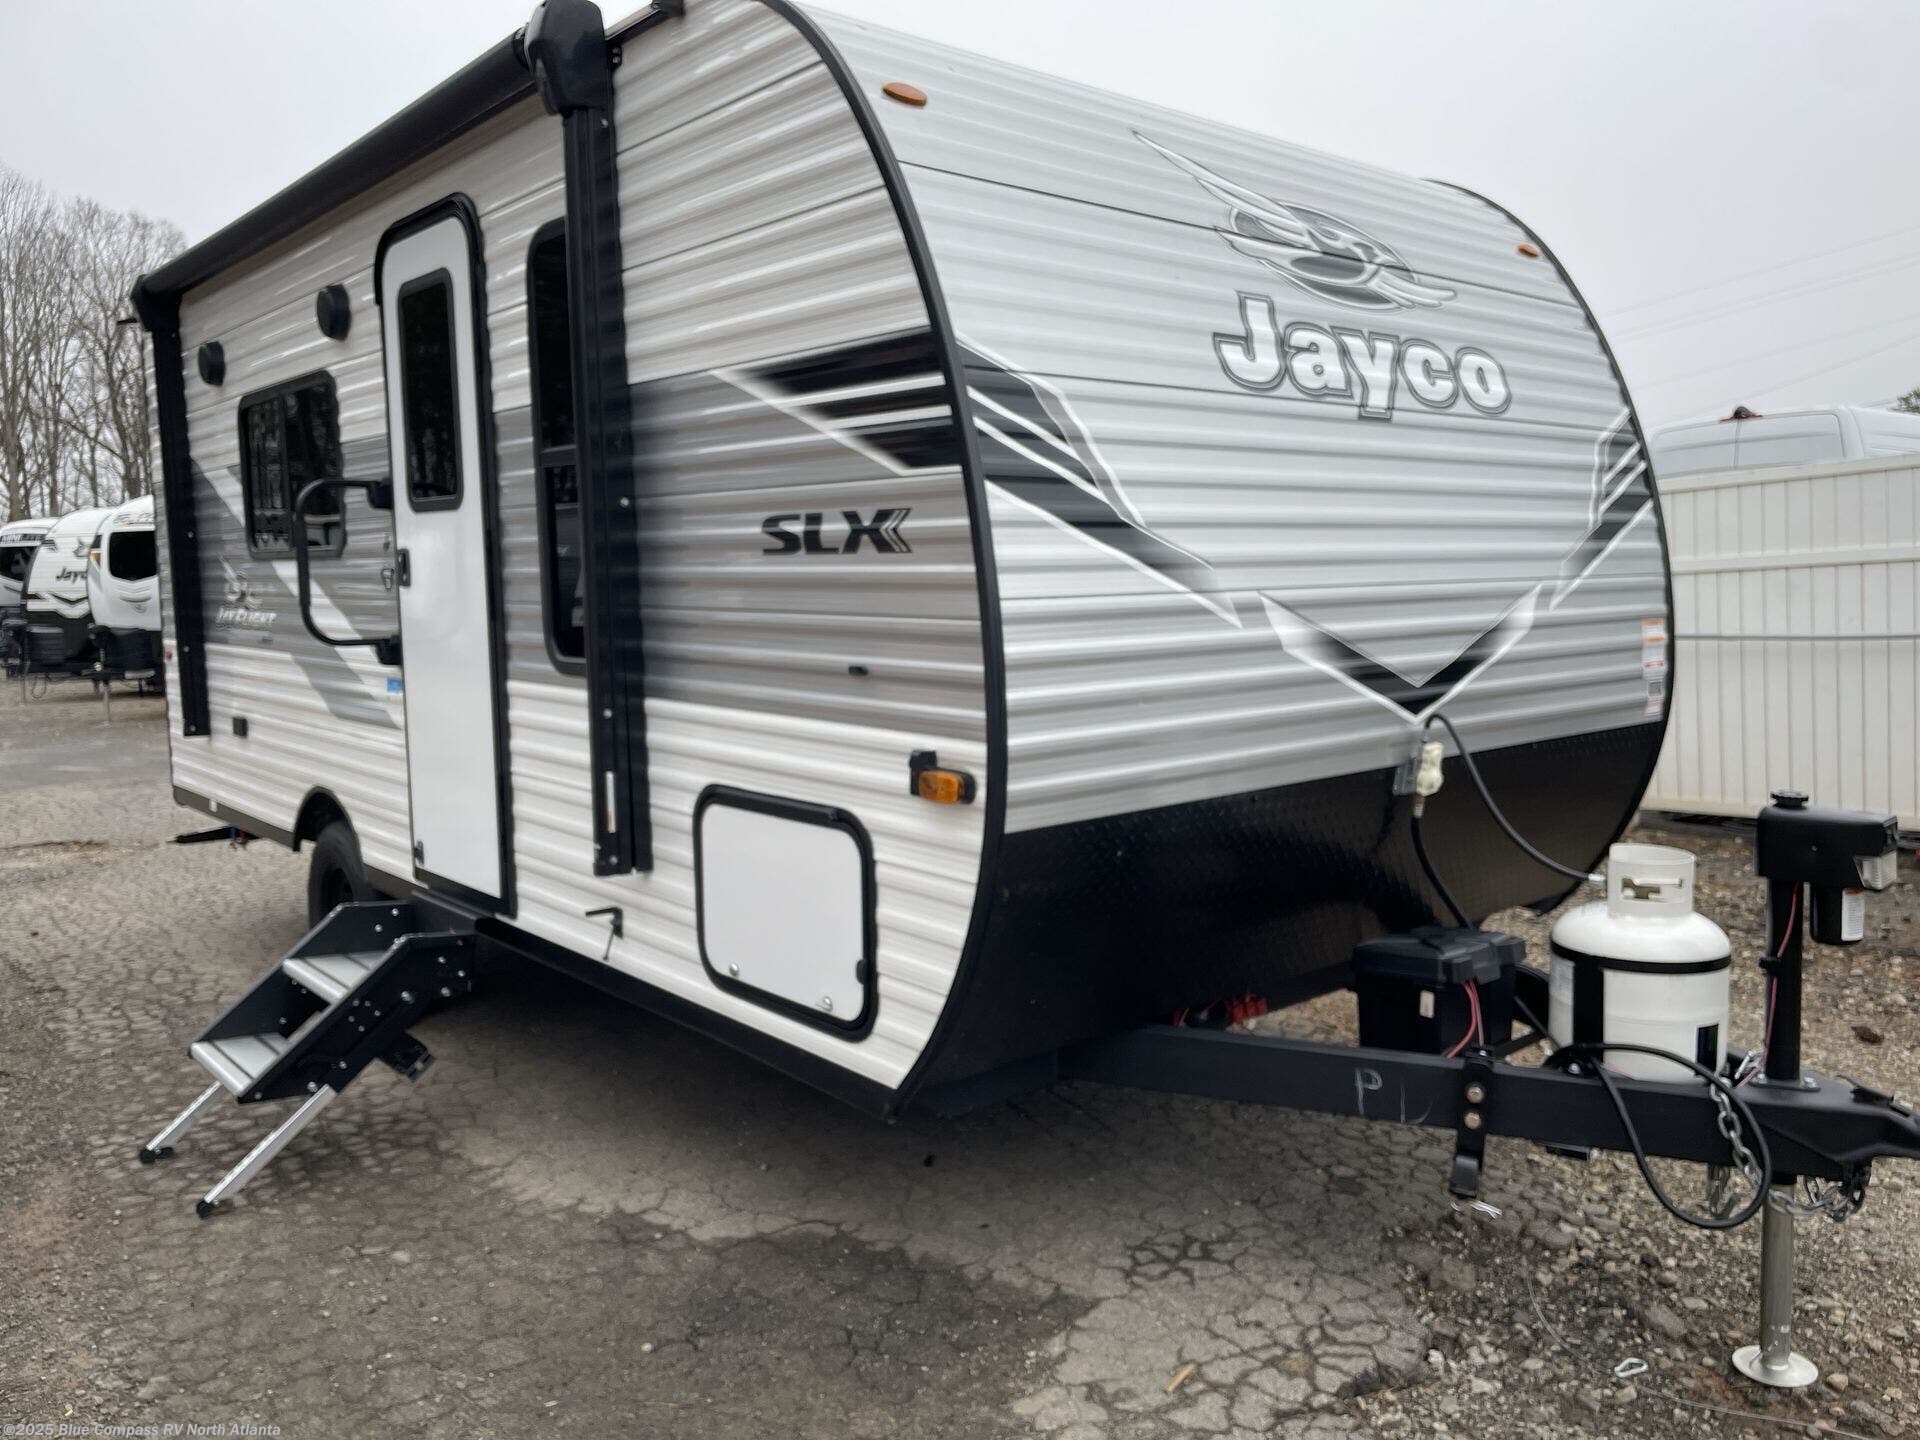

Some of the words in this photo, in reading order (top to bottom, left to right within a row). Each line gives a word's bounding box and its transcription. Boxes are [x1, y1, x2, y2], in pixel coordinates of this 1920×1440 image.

[1212, 290, 1512, 421] Jayco
[761, 507, 912, 556] SLX
[56, 567, 88, 583] Jayc
